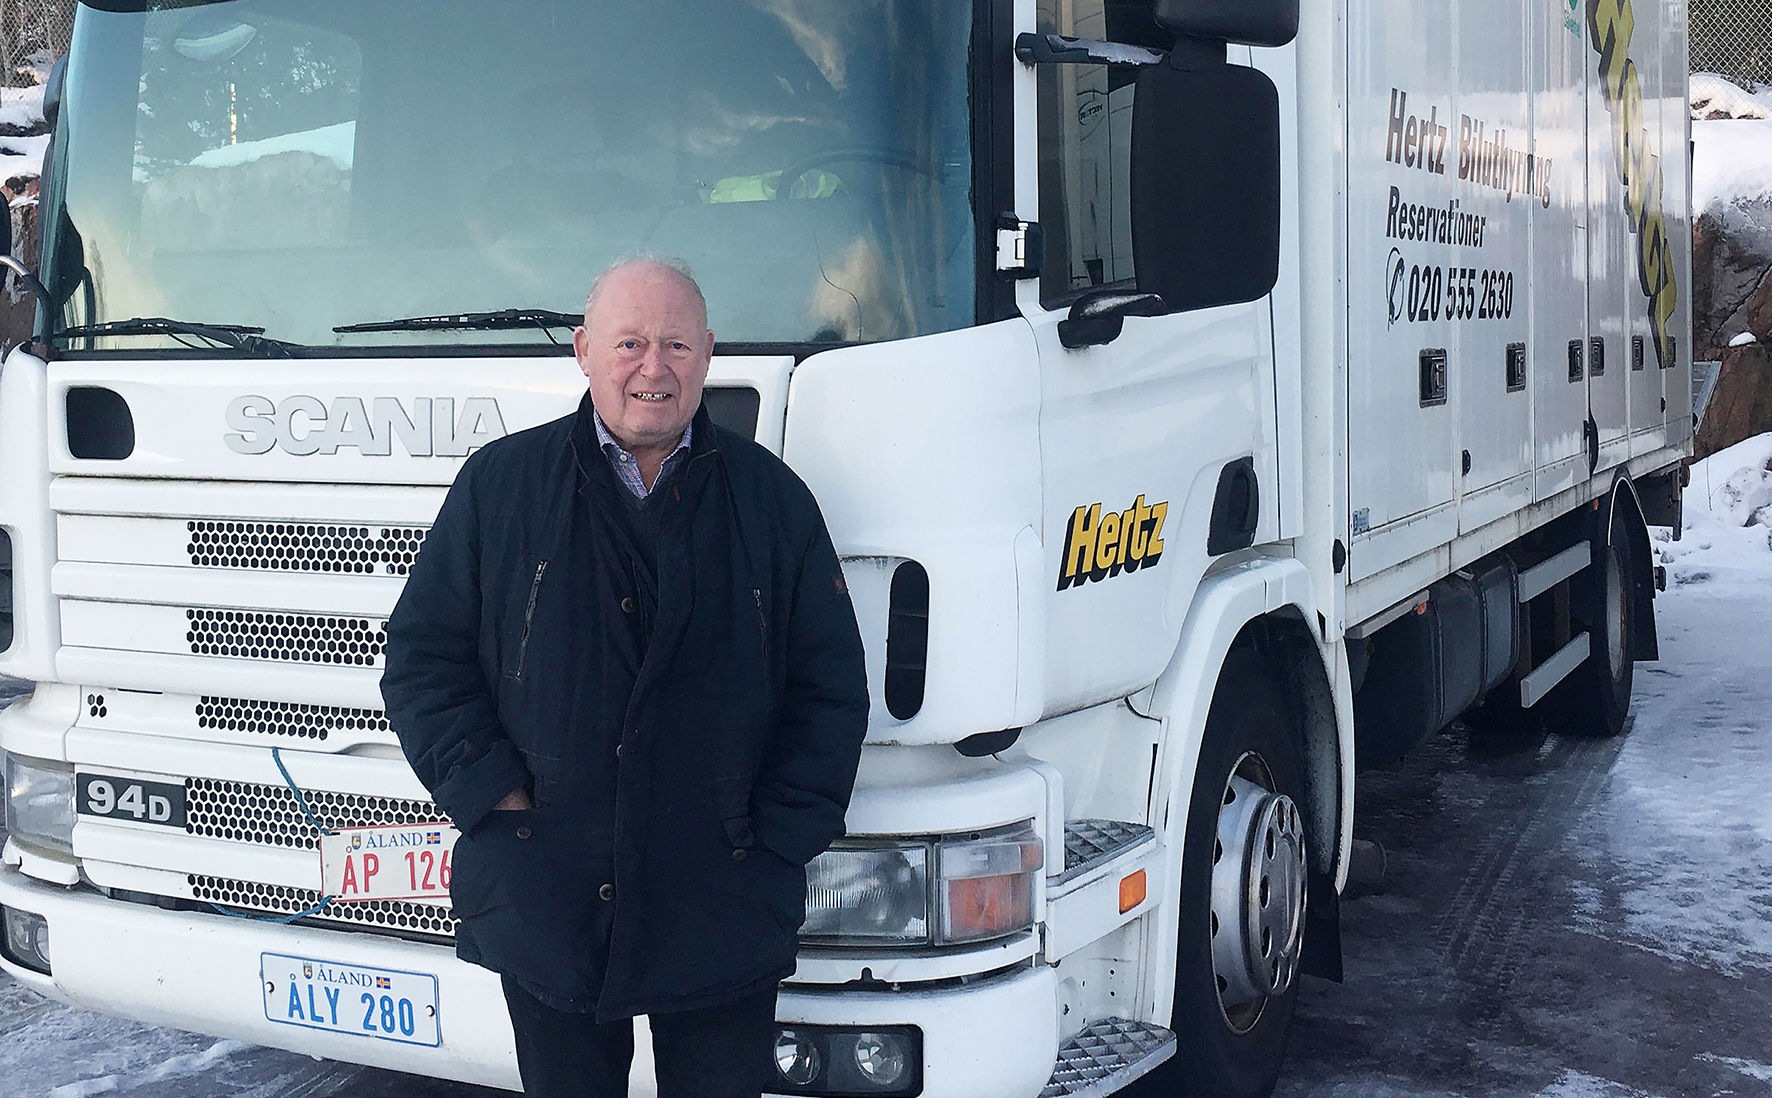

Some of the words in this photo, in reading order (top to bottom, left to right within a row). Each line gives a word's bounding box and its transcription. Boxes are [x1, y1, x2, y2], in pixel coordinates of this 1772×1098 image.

[1385, 88, 1448, 175] Hertz
[1386, 186, 1487, 249] Reservationer
[1407, 265, 1442, 323] 020
[1445, 268, 1477, 321] 555
[1478, 270, 1514, 320] 2630
[223, 395, 508, 457] SCANIA
[1056, 494, 1168, 592] Hertz
[342, 846, 380, 895] ÅP
[404, 850, 452, 891] 126
[365, 831, 423, 849] ÅLAND
[288, 974, 340, 1026] ÅLY
[361, 993, 414, 1037] 280
[317, 964, 373, 988] ÅLAND
